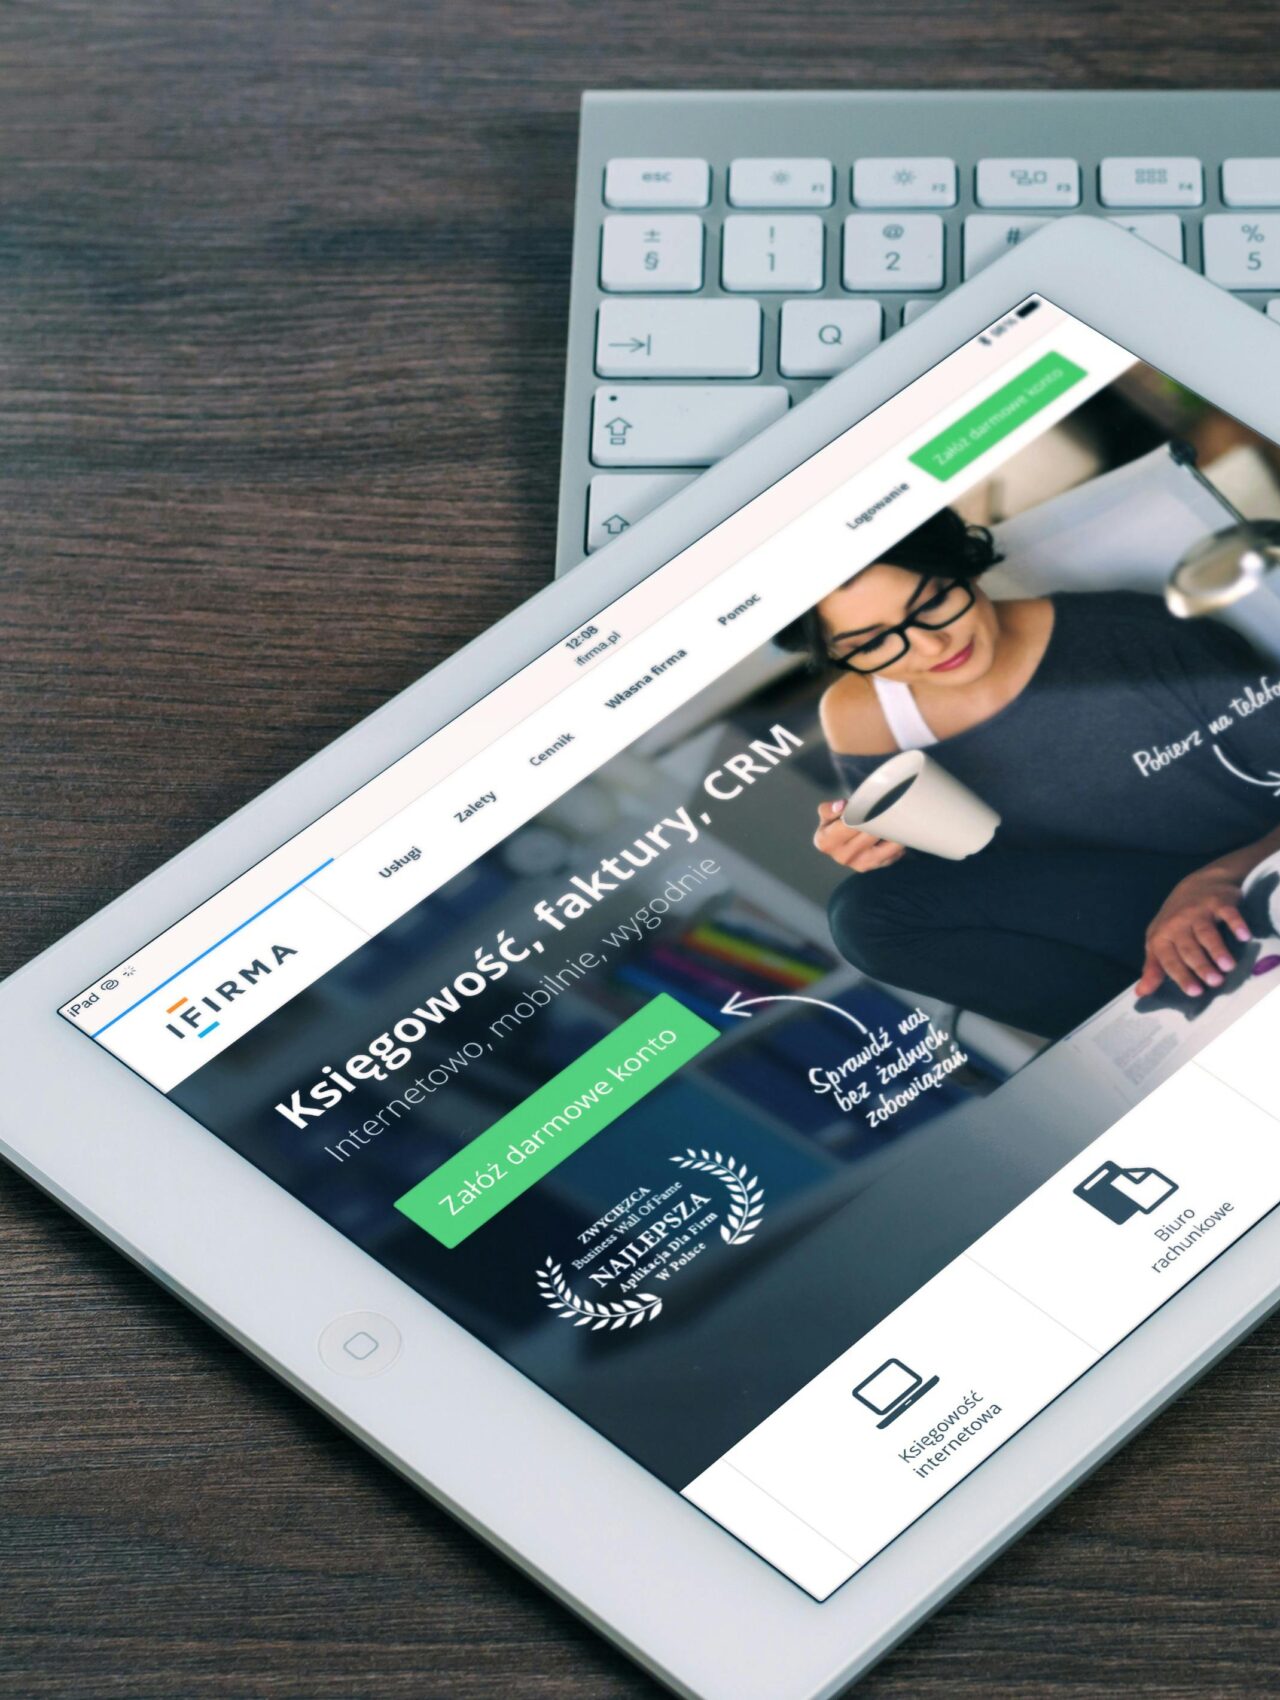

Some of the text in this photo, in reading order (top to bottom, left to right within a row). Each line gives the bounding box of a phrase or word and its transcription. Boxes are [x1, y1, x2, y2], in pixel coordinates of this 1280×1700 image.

[641, 171, 672, 183] esc
[645, 230, 659, 242] ±
[882, 224, 904, 240] @
[1006, 226, 1021, 245] #
[1241, 224, 1265, 243] %
[644, 251, 659, 270] §
[885, 252, 900, 271] 2
[1248, 252, 1261, 270] 5
[818, 325, 842, 345] Q
[846, 481, 910, 530] Logowanie
[717, 592, 761, 627] Pomoc
[565, 624, 599, 651] 12:08
[575, 631, 622, 668] ifirma.pl
[604, 648, 688, 710] Własna firma
[529, 732, 575, 767] Cennik
[1132, 730, 1203, 777] Pobierz
[1208, 714, 1234, 735] na
[453, 789, 498, 825] Zalety
[378, 845, 423, 880] Usługi
[274, 723, 805, 1130] Księgowość, faktury, CRM
[68, 992, 100, 1018] iPad
[166, 944, 298, 1039] IFIRMA
[324, 855, 722, 1164] Internetowo, mobilnie, wygodnie
[808, 1007, 930, 1094] Sprawdź nas
[833, 1023, 948, 1112] bez żadnych
[866, 1044, 968, 1128] zobowiązań
[439, 1027, 677, 1217] Załóż darmowe konto
[571, 1181, 683, 1270] Business Wall Of Fame
[577, 1186, 651, 1245] ZWYCIĘZCA
[1154, 1206, 1196, 1242] Biuro
[588, 1192, 712, 1288] NAJLEPSZA
[619, 1212, 718, 1293] Aplikacja Dla Firm
[1150, 1199, 1235, 1274] rachunkowe
[654, 1242, 706, 1281] W Polsce
[898, 1389, 985, 1464] Księgowość
[913, 1402, 1003, 1479] internetowa
